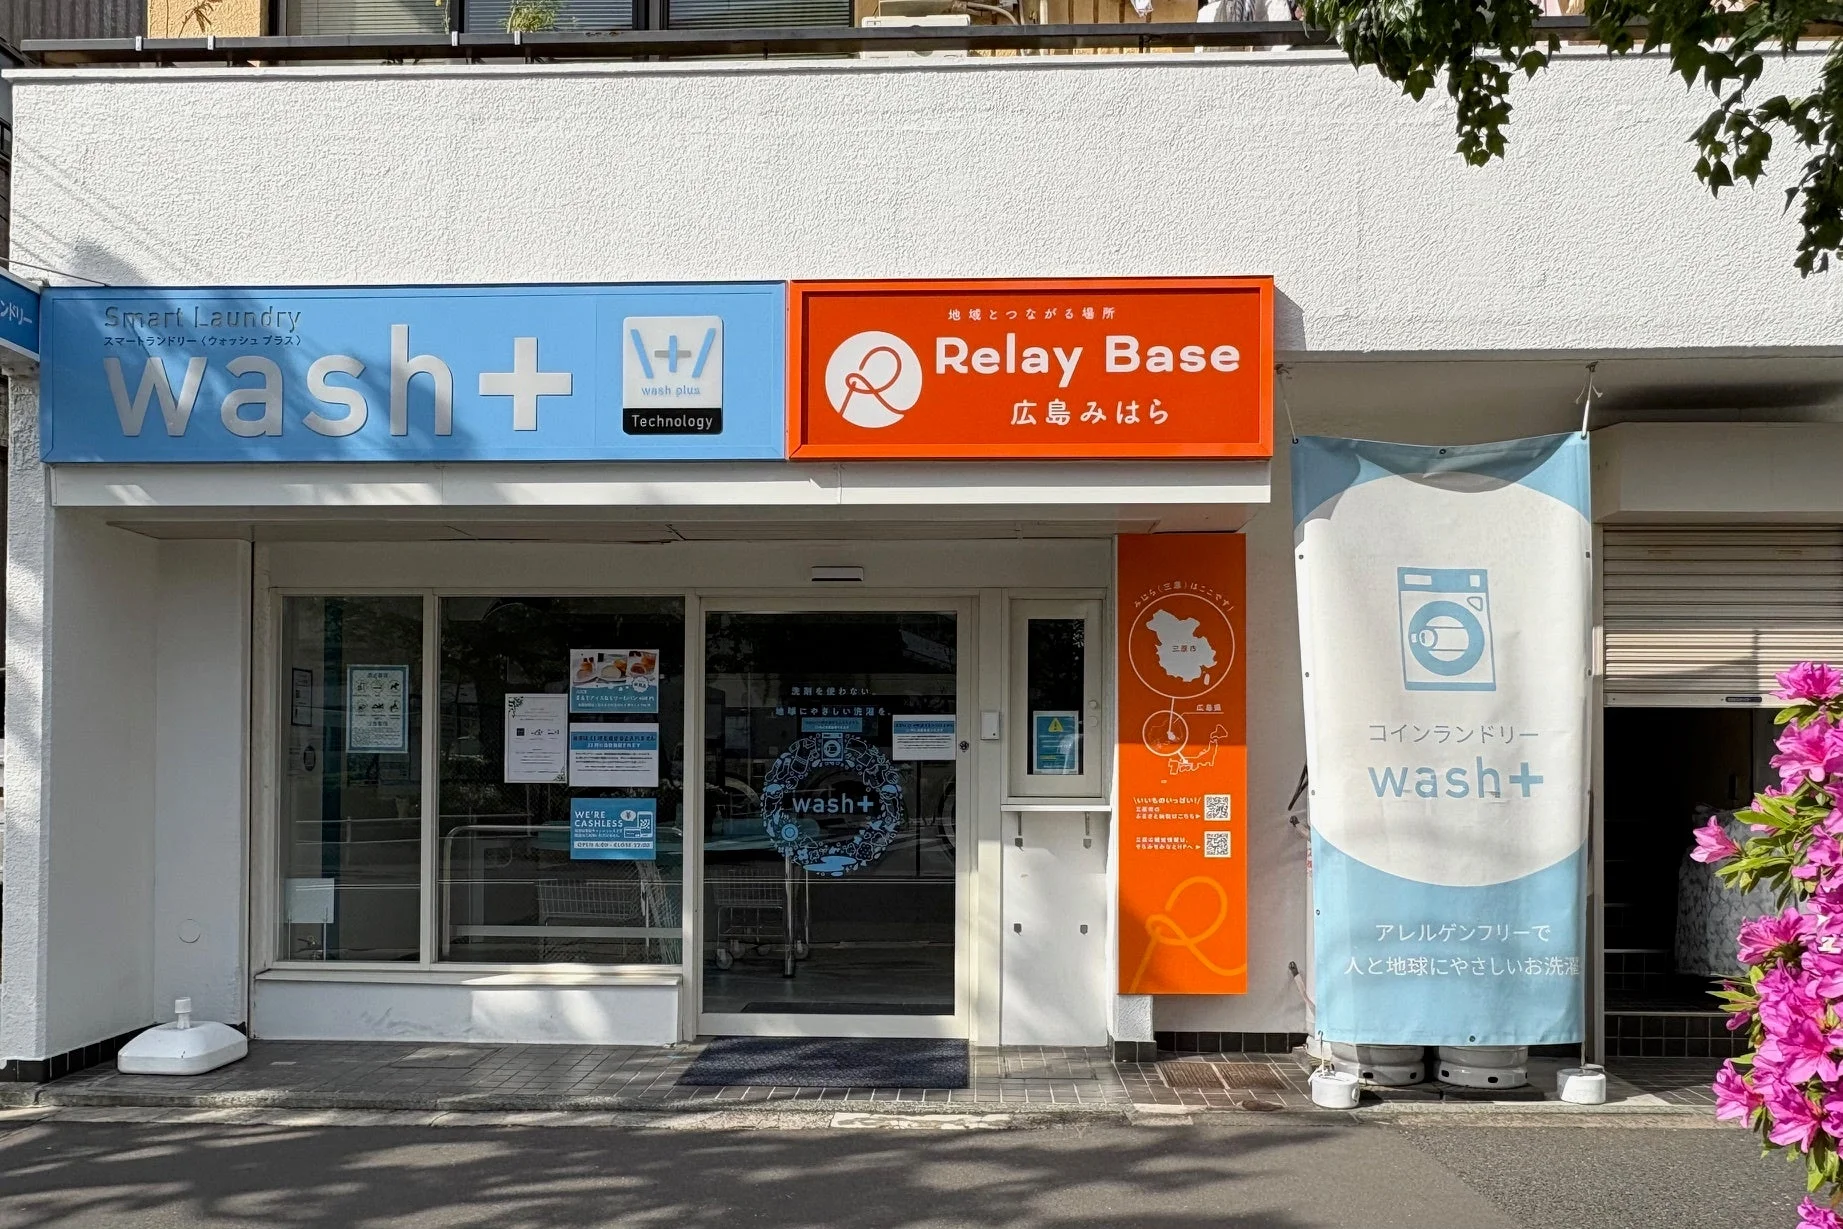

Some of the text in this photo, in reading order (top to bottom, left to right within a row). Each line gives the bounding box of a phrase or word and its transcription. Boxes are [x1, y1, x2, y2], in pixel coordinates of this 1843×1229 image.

[104, 305, 302, 333] Smart Laundry
[948, 307, 1117, 321] 地域とつながる場所
[935, 333, 1241, 387] Relay Base
[641, 385, 701, 398] wash plus
[1010, 399, 1170, 425] 広島みはら
[631, 414, 713, 430] Technology
[791, 687, 876, 696] 洗剤を使わない。
[775, 707, 891, 716] 地球にやさしい洗濯を。
[1369, 724, 1539, 745] コインランドリー
[1368, 756, 1545, 799] wash+
[792, 793, 874, 813] wash+
[574, 819, 623, 828] CASHLESS
[575, 810, 606, 819] WE'RE
[1375, 924, 1551, 942] アレルゲンフリーで
[1344, 956, 1581, 977] 人と地球にやさしいお洗濯
